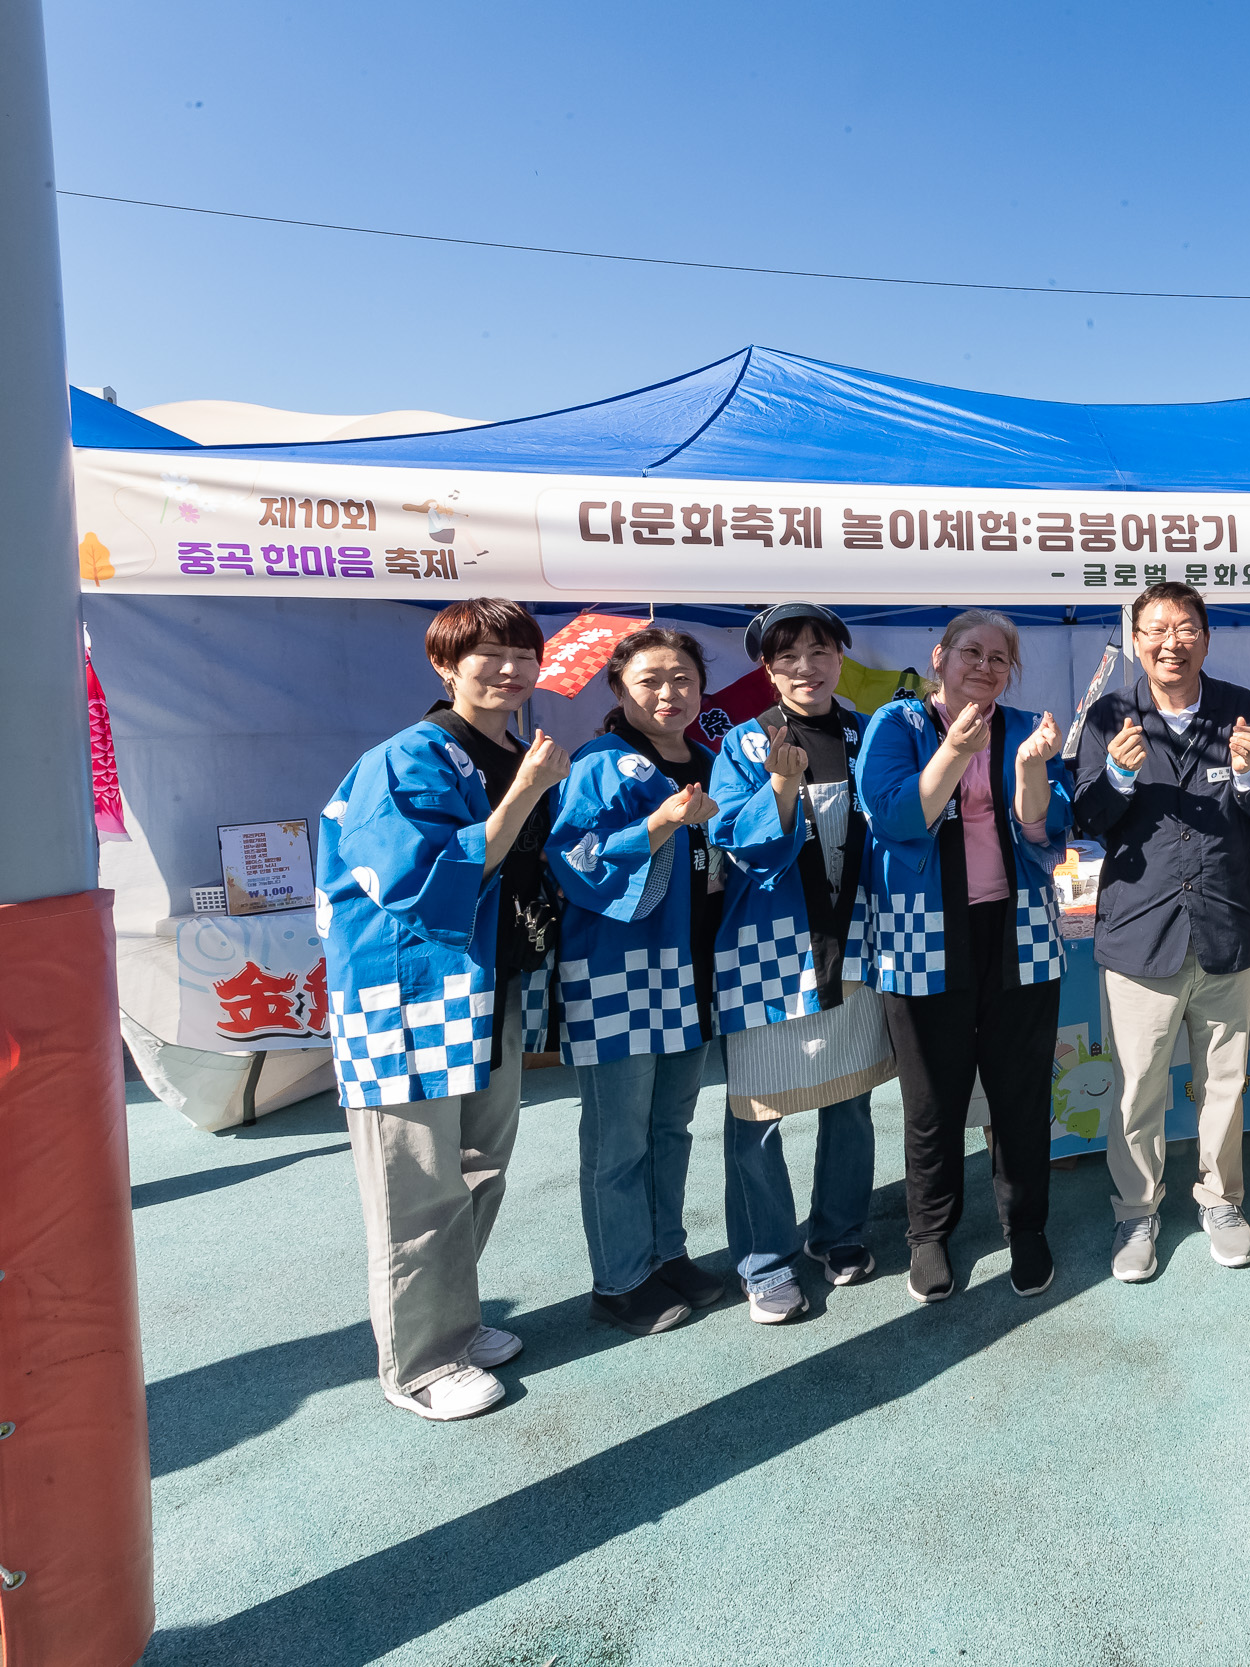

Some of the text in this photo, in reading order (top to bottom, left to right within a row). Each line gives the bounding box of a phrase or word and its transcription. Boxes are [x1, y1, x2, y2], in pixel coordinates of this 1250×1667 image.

[259, 496, 377, 532] 제10회
[578, 500, 823, 549] 다문화축제
[177, 541, 460, 581] 중곡 한마음 축제
[1083, 563, 1168, 587] 글로벌
[262, 886, 294, 897] 1,000
